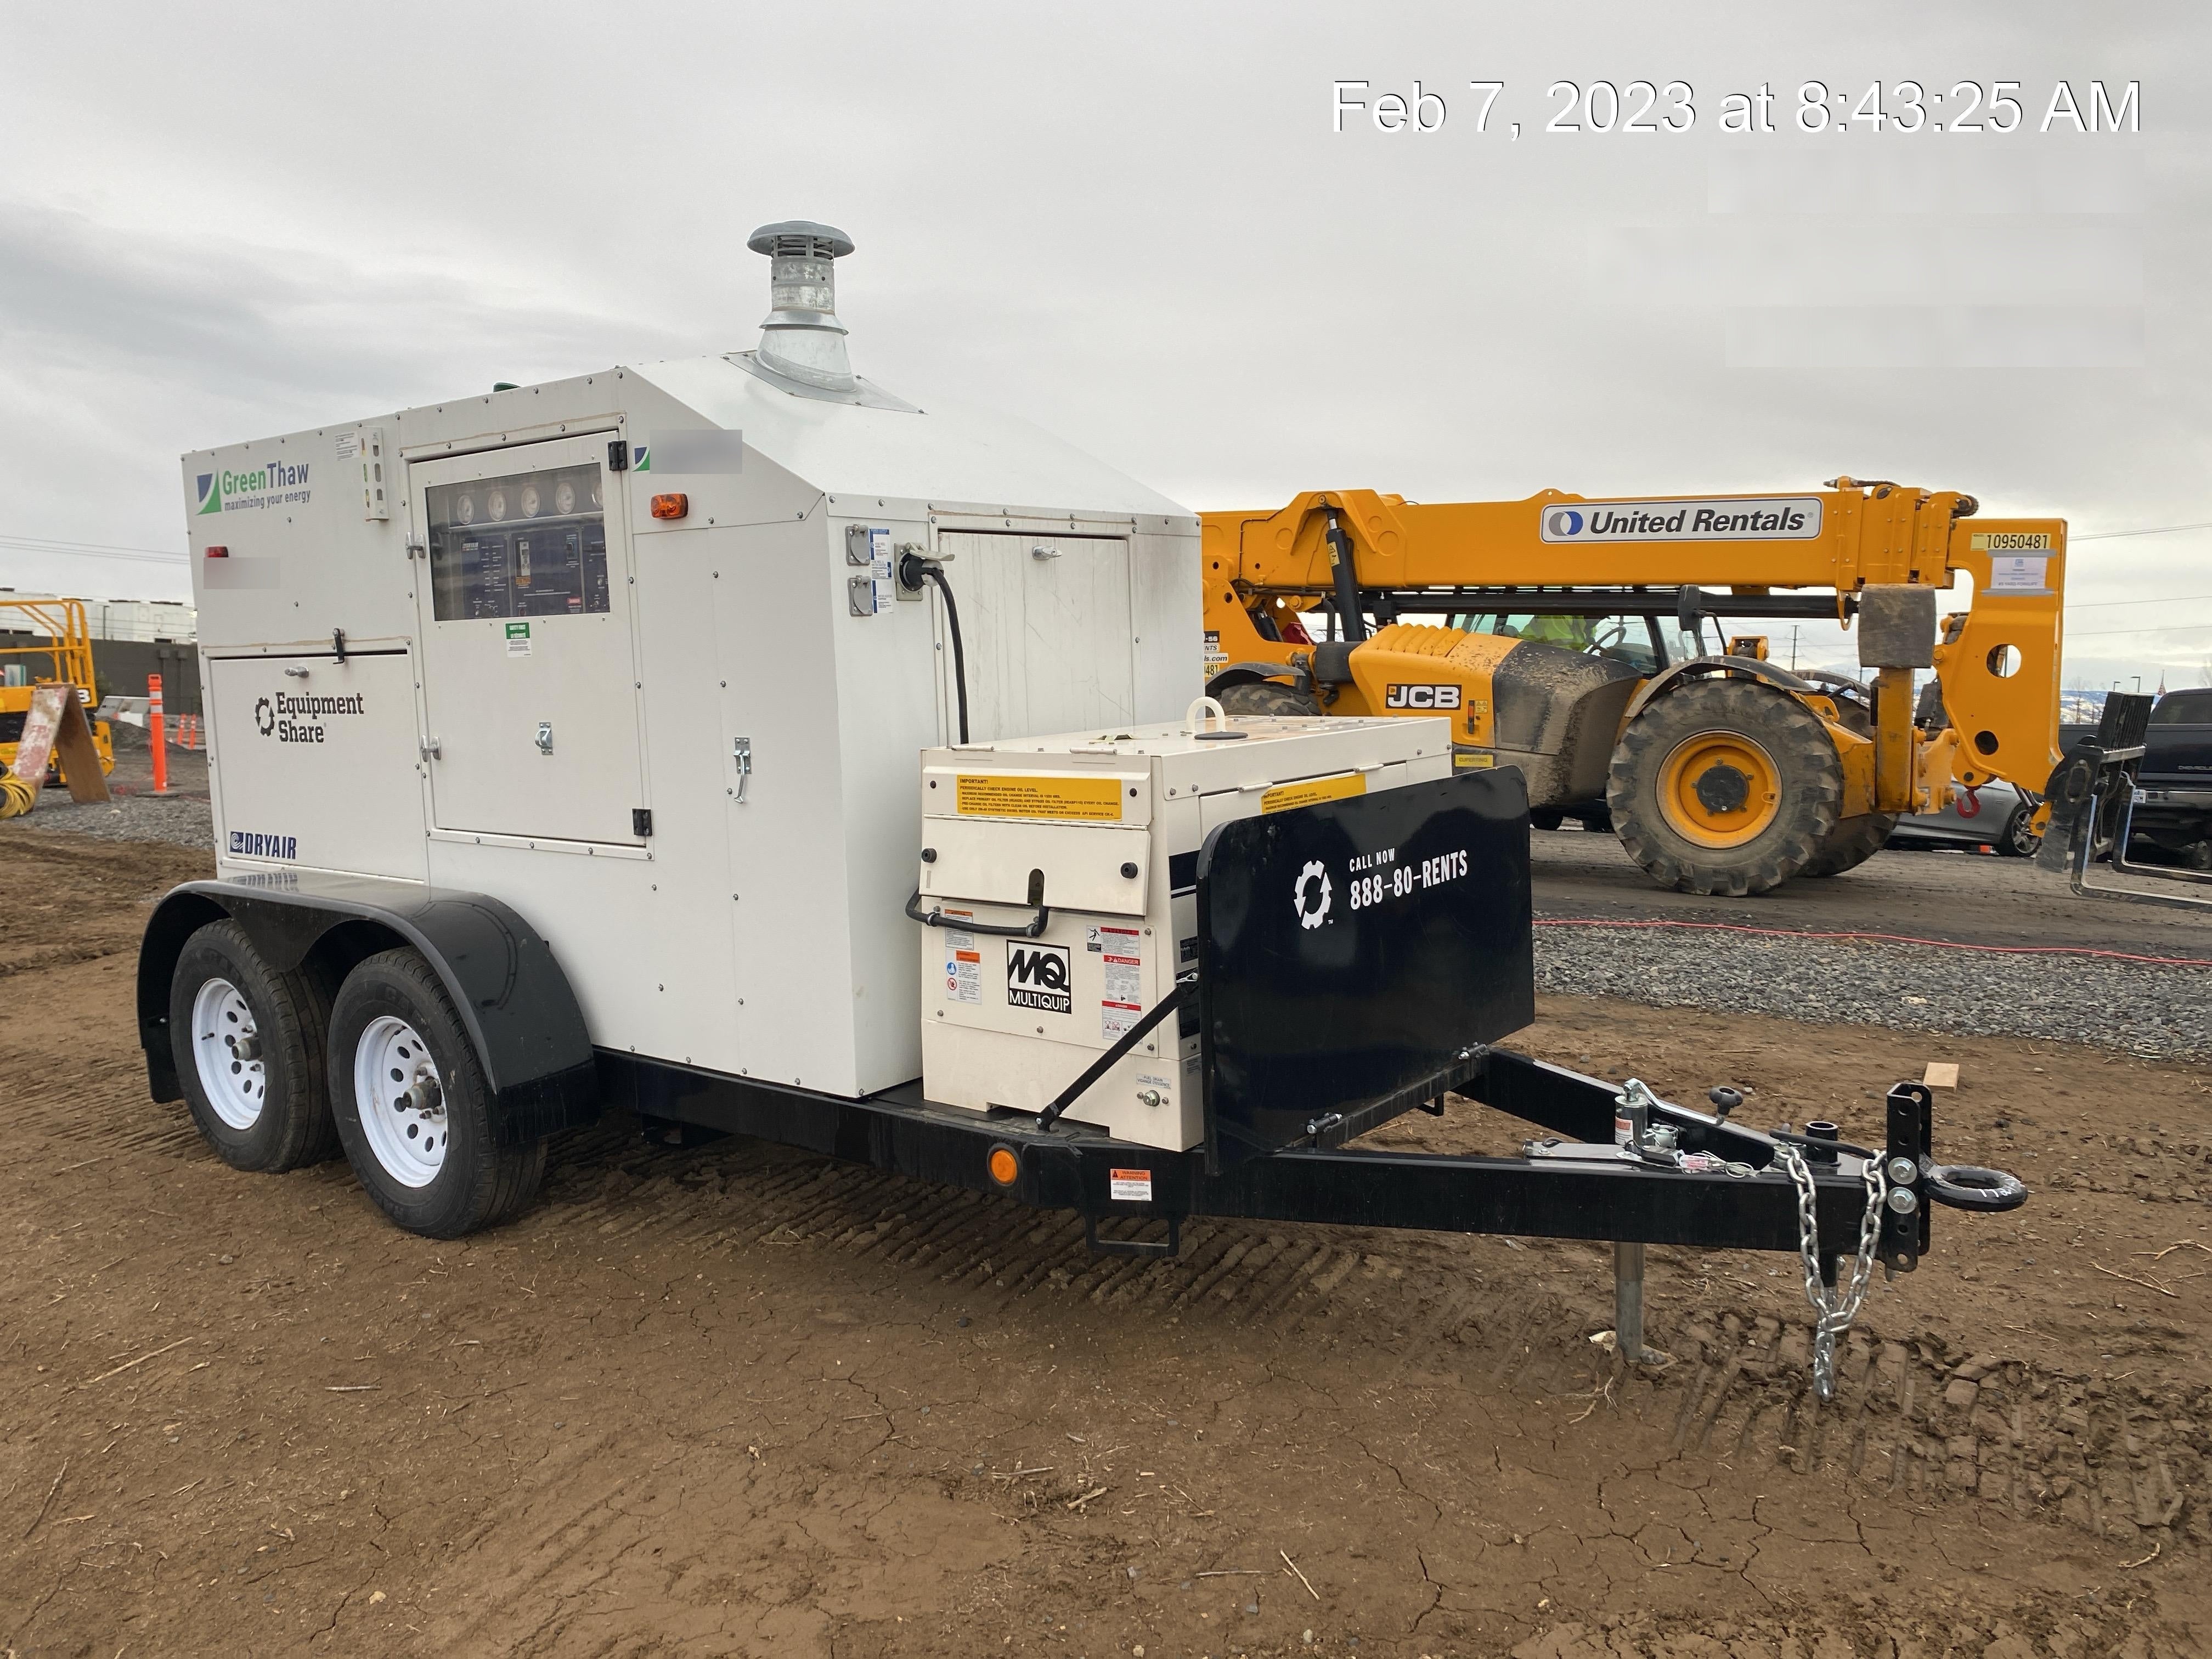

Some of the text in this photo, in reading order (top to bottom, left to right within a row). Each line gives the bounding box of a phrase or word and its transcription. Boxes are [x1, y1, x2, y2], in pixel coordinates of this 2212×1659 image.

[223, 460, 309, 495] GreenThaw
[224, 490, 311, 511] maximizing your energy
[1590, 507, 1805, 534] United Rentals
[1987, 534, 2047, 549] 10950481
[1204, 664, 1218, 675] 481
[275, 691, 364, 719] Equipment
[1388, 685, 1460, 708] JCB
[278, 720, 324, 743] Share
[245, 832, 297, 860] DRYAIR
[1350, 848, 1395, 872] CALL NOW
[1350, 849, 1468, 910] 888-80-RENTS
[1008, 949, 1069, 996] MQ
[1009, 990, 1070, 1012] MULTIQUIP
